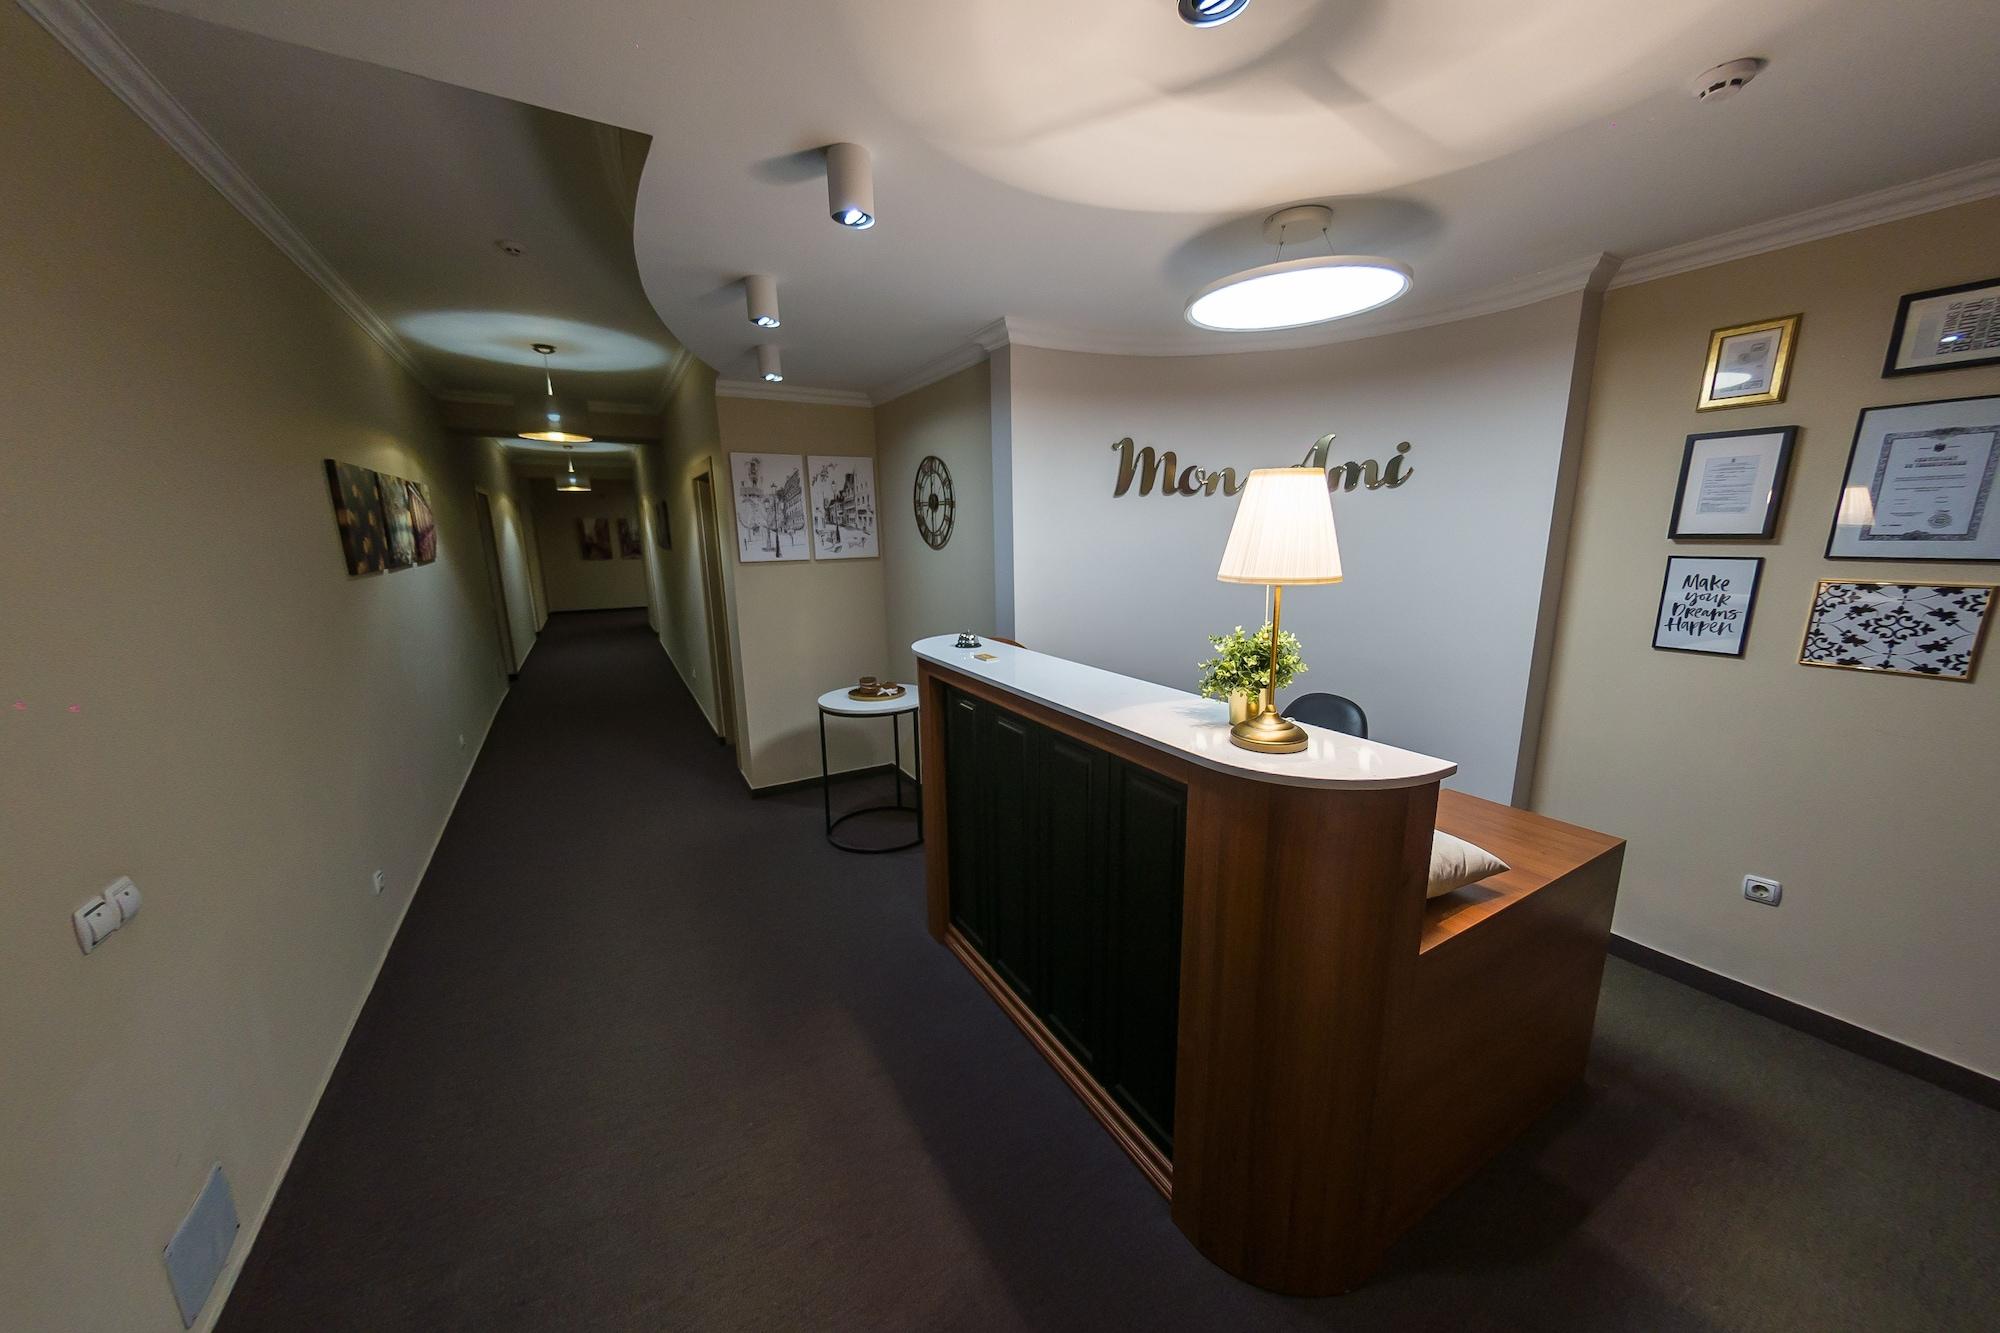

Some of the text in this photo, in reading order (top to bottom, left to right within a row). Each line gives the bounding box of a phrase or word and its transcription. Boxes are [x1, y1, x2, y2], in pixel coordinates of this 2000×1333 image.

[1112, 437, 1248, 497] Mon
[1681, 573, 1730, 592] Make
[1663, 616, 1735, 636] Happen
